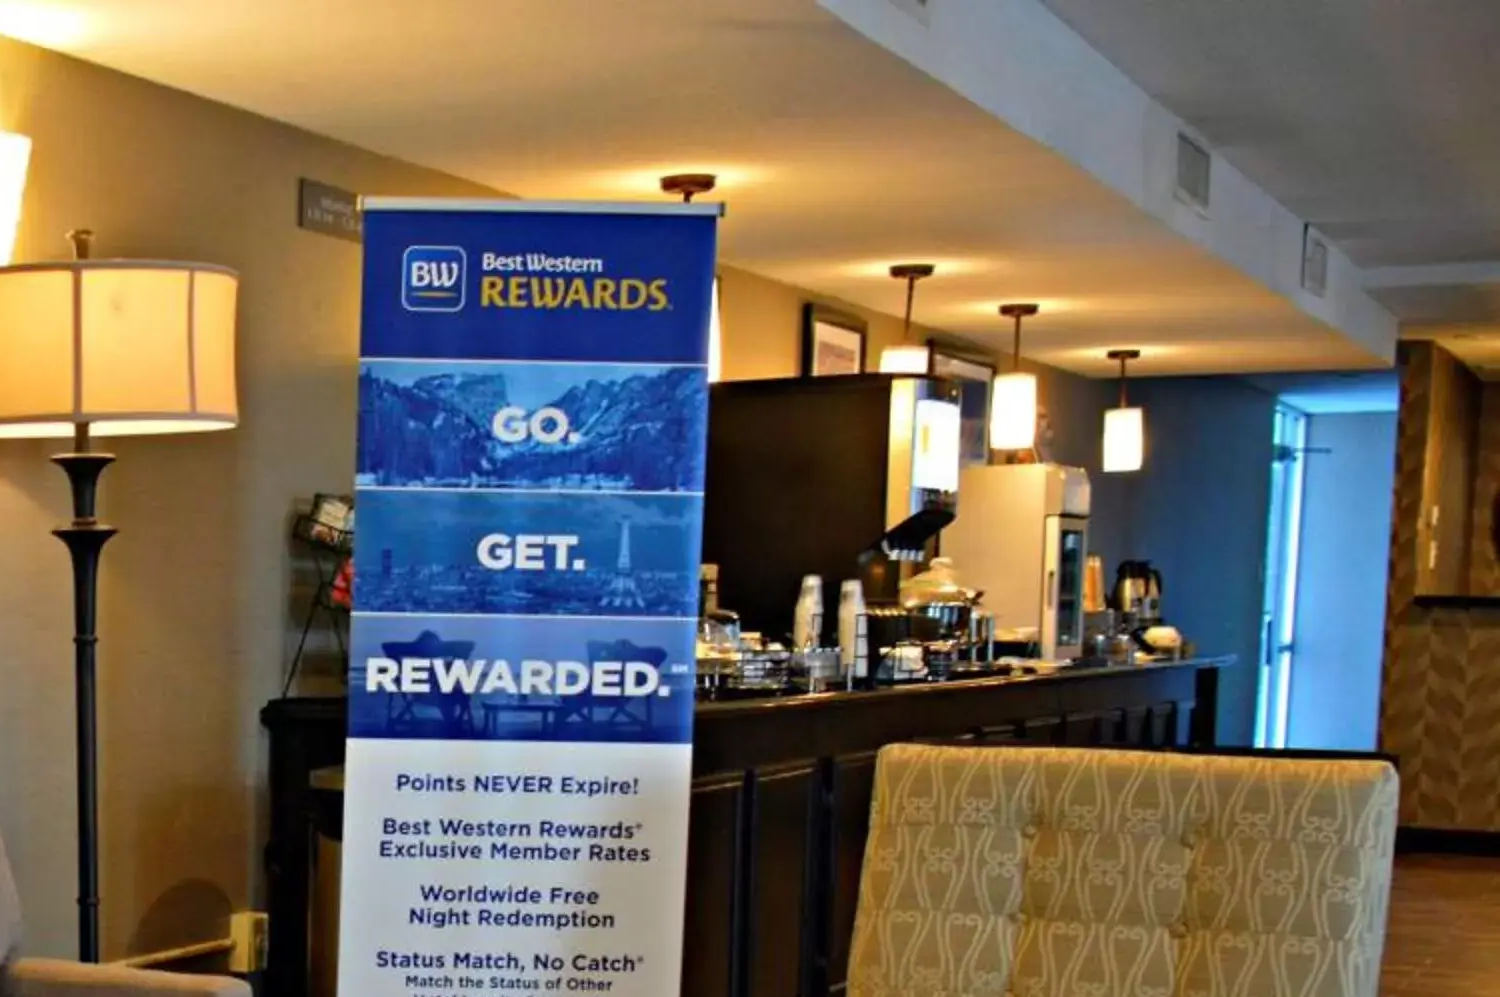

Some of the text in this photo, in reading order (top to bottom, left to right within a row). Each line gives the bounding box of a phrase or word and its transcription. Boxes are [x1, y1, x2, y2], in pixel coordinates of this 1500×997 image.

[411, 261, 459, 287] BW
[482, 252, 603, 273] Best Western
[480, 275, 668, 310] REWARDS
[491, 406, 580, 445] GO.
[477, 533, 585, 571] GET.
[364, 657, 671, 697] REWARDED.
[396, 773, 639, 797] Points NEVER Expire!
[383, 817, 431, 835] Best
[439, 818, 531, 837] Western
[379, 840, 651, 862] Exclusive Member Rates
[420, 885, 600, 905] Worldwide Free
[409, 907, 615, 930] Night Redemption
[376, 950, 445, 969] Status
[453, 952, 525, 973] Match,
[533, 954, 565, 971] No
[405, 975, 613, 991] Match the Status of Other
